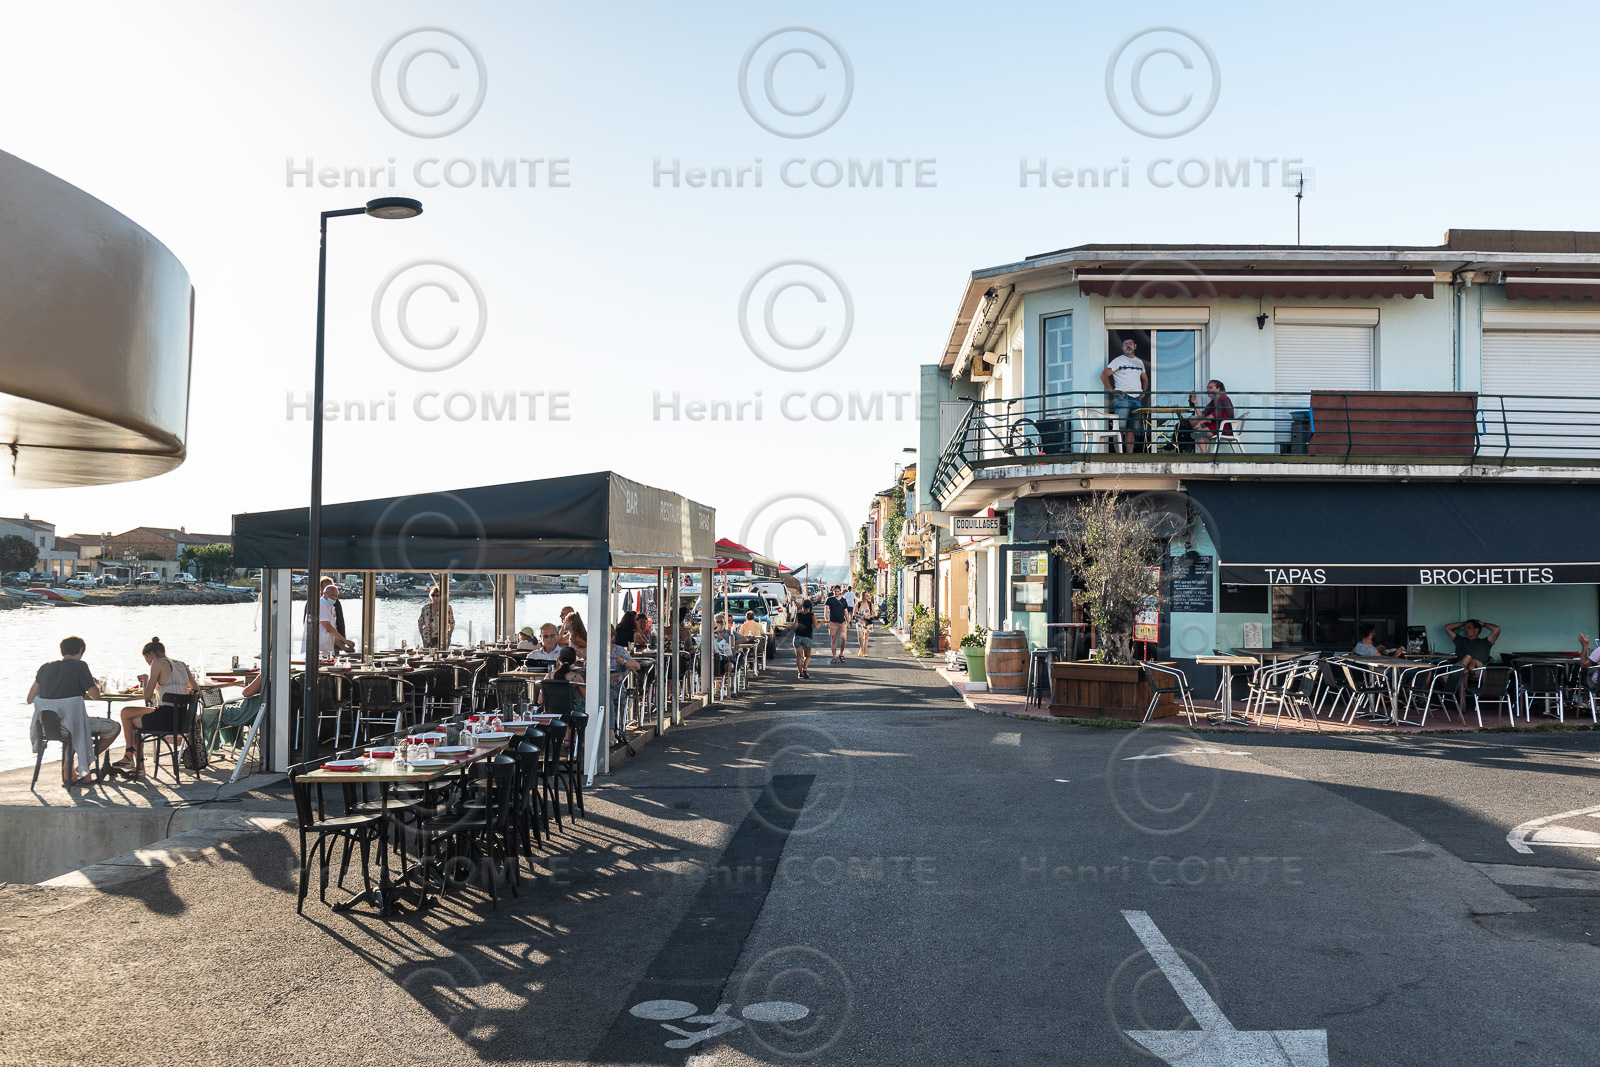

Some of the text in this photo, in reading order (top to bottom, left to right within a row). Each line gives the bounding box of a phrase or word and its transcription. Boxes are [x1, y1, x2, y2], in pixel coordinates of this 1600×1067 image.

[626, 490, 639, 516] BAR
[956, 519, 999, 530] COQUILLAGES
[1264, 567, 1554, 585] TAPAS BROCHETTES
